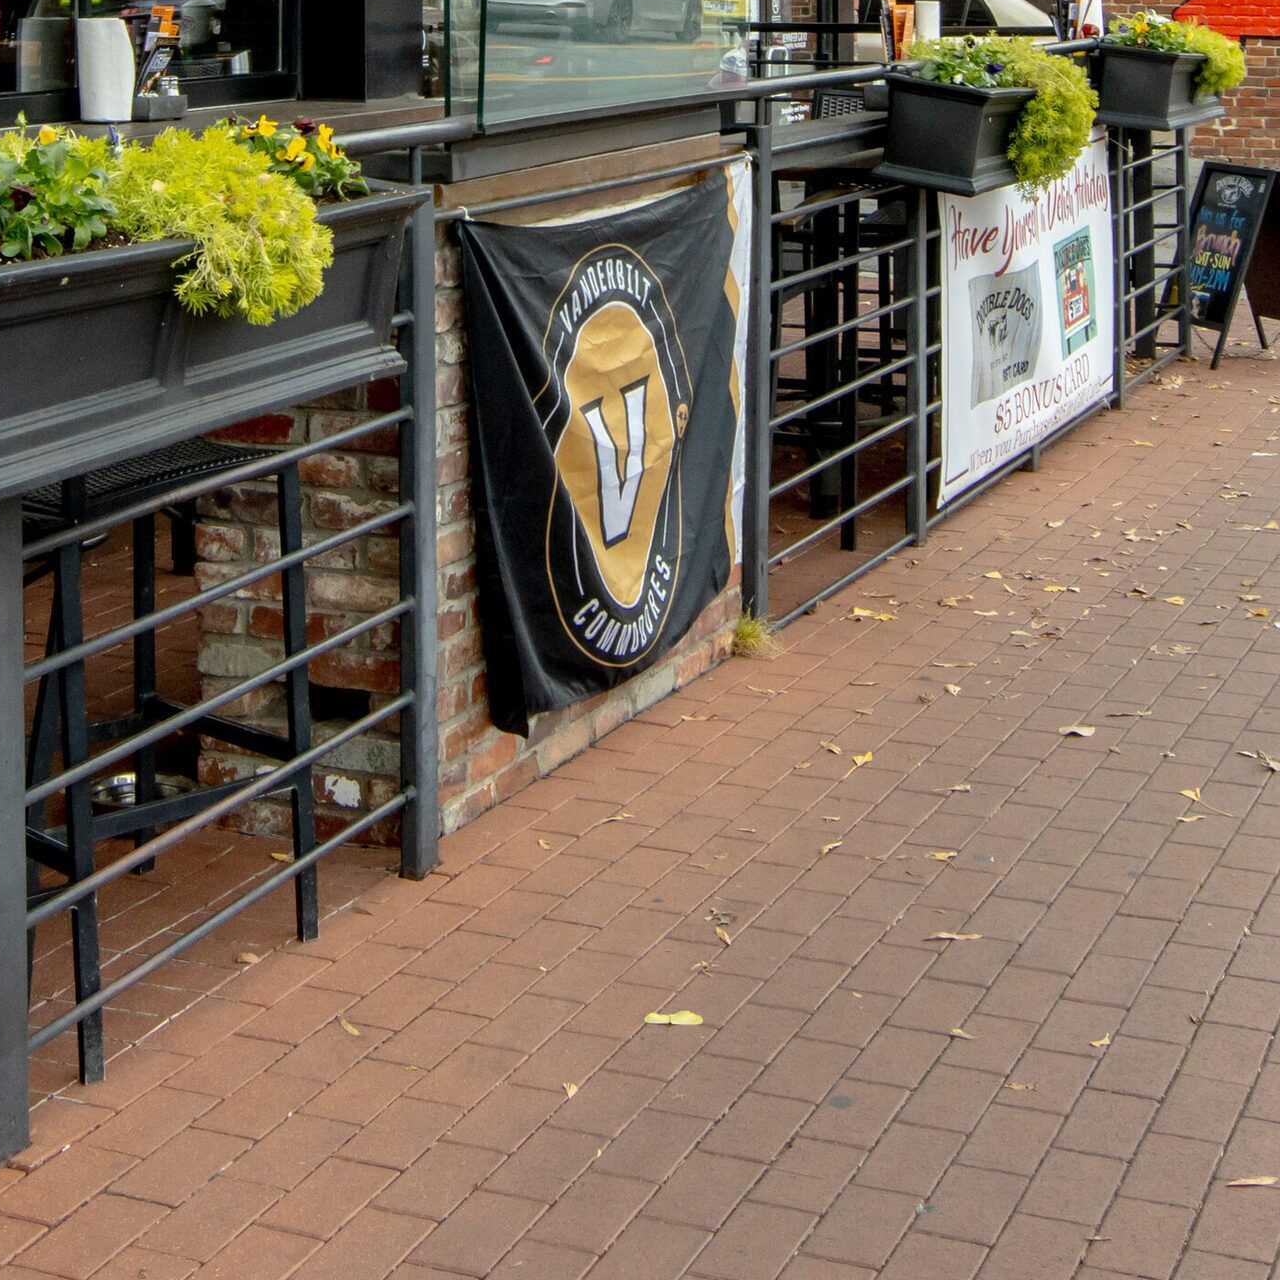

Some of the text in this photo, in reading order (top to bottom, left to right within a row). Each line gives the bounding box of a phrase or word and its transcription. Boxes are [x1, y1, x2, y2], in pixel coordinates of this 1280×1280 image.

[950, 205, 999, 271] Have
[1074, 163, 1109, 218] Holiday
[1193, 224, 1242, 268] Brunch
[1230, 208, 1246, 230] for
[559, 256, 653, 337] VANDERBILT
[976, 289, 1011, 334] DOUBLE
[1007, 287, 1034, 324] DOGS
[994, 353, 1090, 437] $5 BONUS CARD
[580, 374, 651, 550] V
[573, 558, 673, 657] COMMODORES
